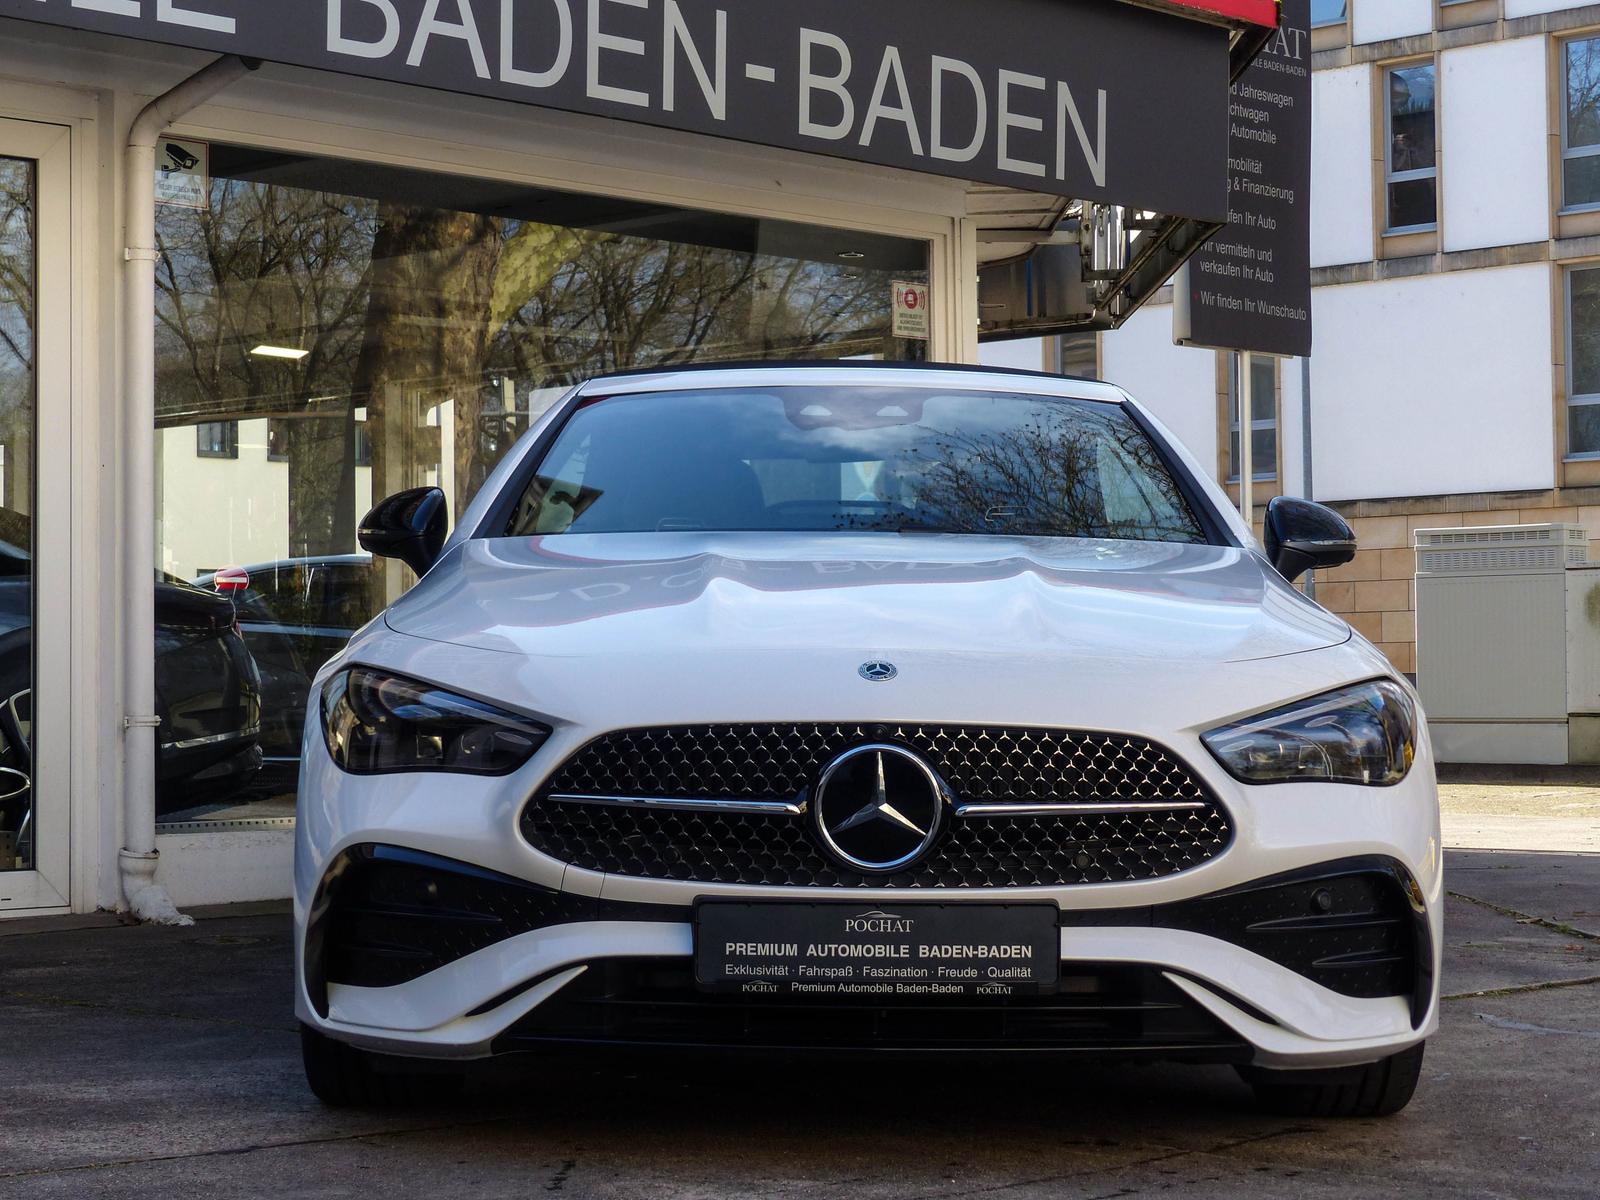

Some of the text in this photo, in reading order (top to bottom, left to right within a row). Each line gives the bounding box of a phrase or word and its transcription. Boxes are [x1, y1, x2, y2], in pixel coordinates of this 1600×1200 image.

[1263, 25, 1307, 60] AT
[1263, 59, 1307, 77] BADEN-BADEN
[1239, 82, 1294, 108] Jahreswagen
[1230, 122, 1277, 144] Automobile
[1233, 176, 1240, 191] &
[1242, 178, 1294, 204] Finanzierung
[1245, 211, 1256, 226] Ihr
[1257, 213, 1277, 230] Auto
[1215, 242, 1255, 259] vermitteln
[1257, 248, 1272, 262] und
[1200, 259, 1274, 283] verkaufen Ihr Auto
[1200, 290, 1307, 321] Wir finden Ihr Wunschauto
[845, 919, 914, 933] POCHAT
[725, 942, 1033, 959] PREMIUM AUTOMOBILE BADEN-BADEN
[725, 963, 1032, 979] Exklusivität Fahrspaß Faszination Freude Qualität
[742, 982, 1013, 995] POCHAT Premium Automobile Baden-Baden POCHAT
